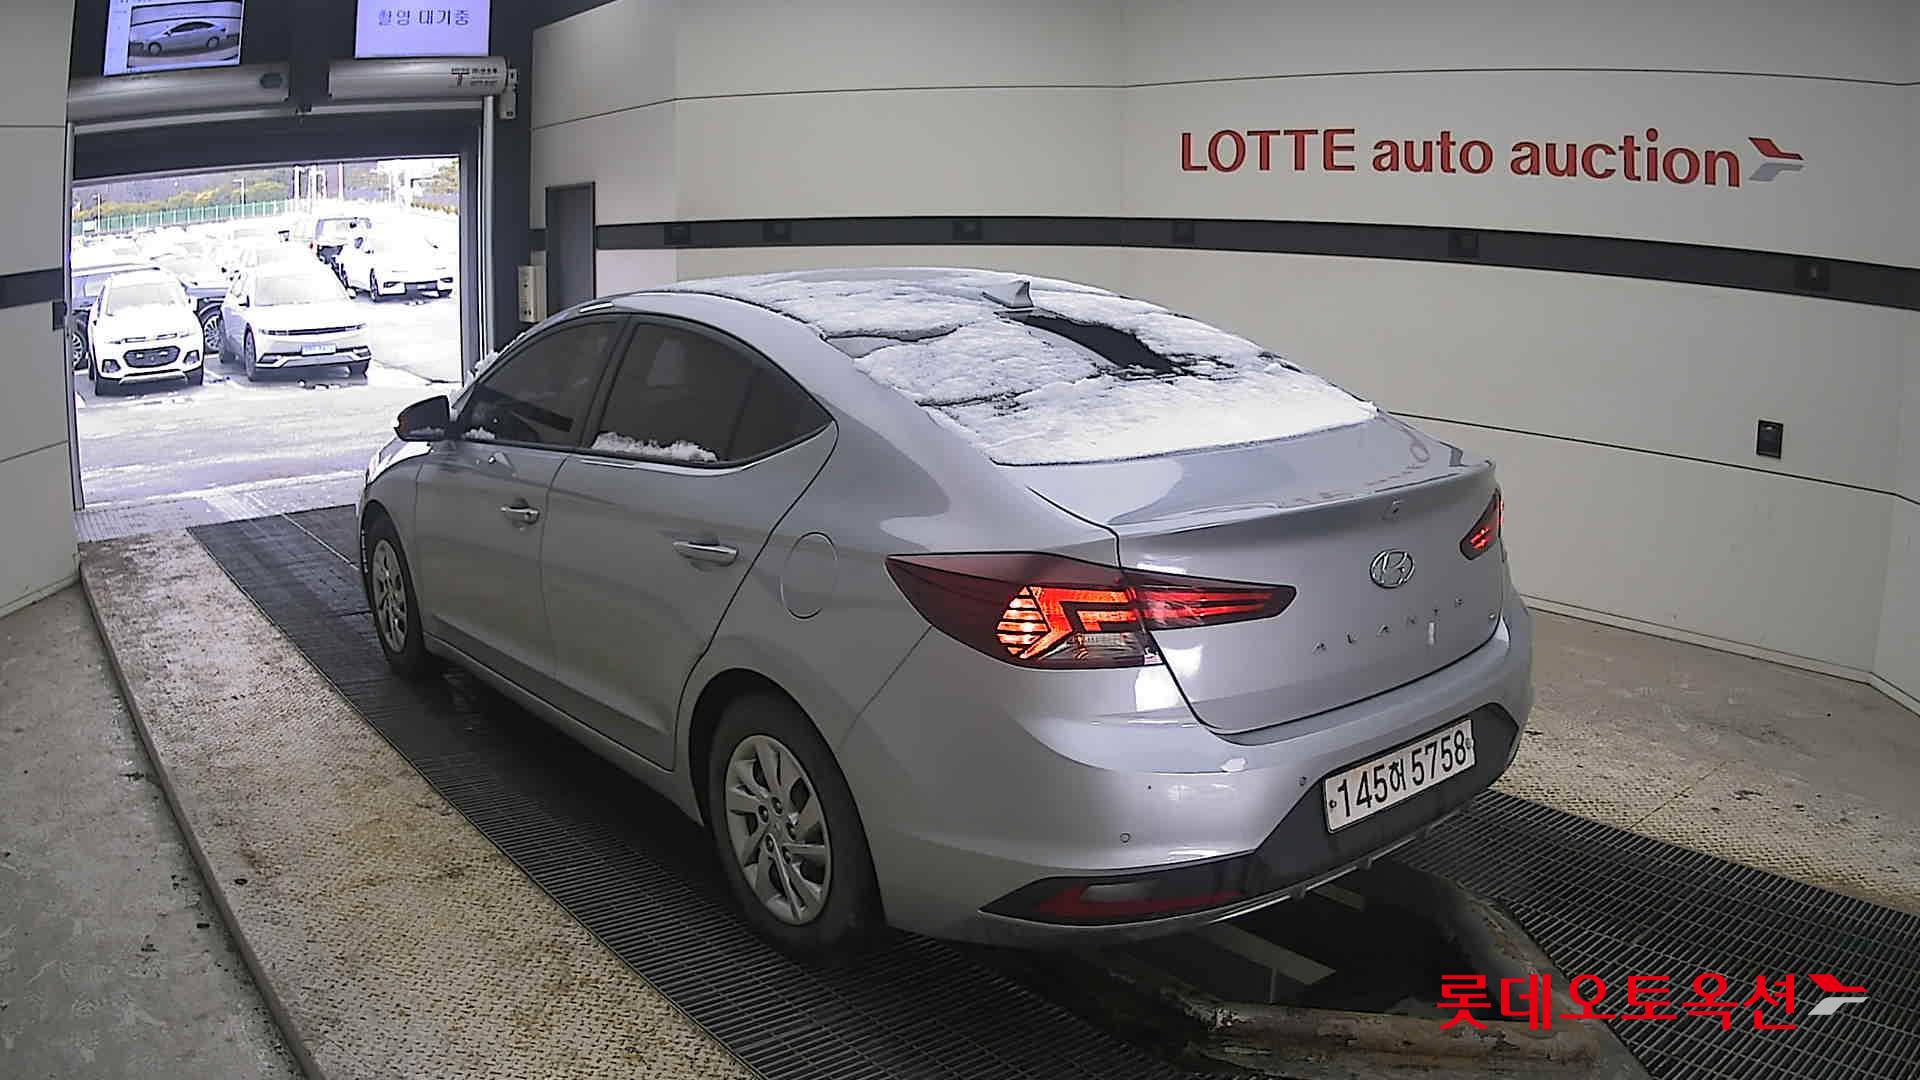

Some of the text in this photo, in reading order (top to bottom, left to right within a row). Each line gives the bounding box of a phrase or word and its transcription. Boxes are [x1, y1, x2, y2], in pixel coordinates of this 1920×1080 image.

[419, 8, 469, 27] 대기중
[1180, 127, 1741, 187] LOTTE auto auction
